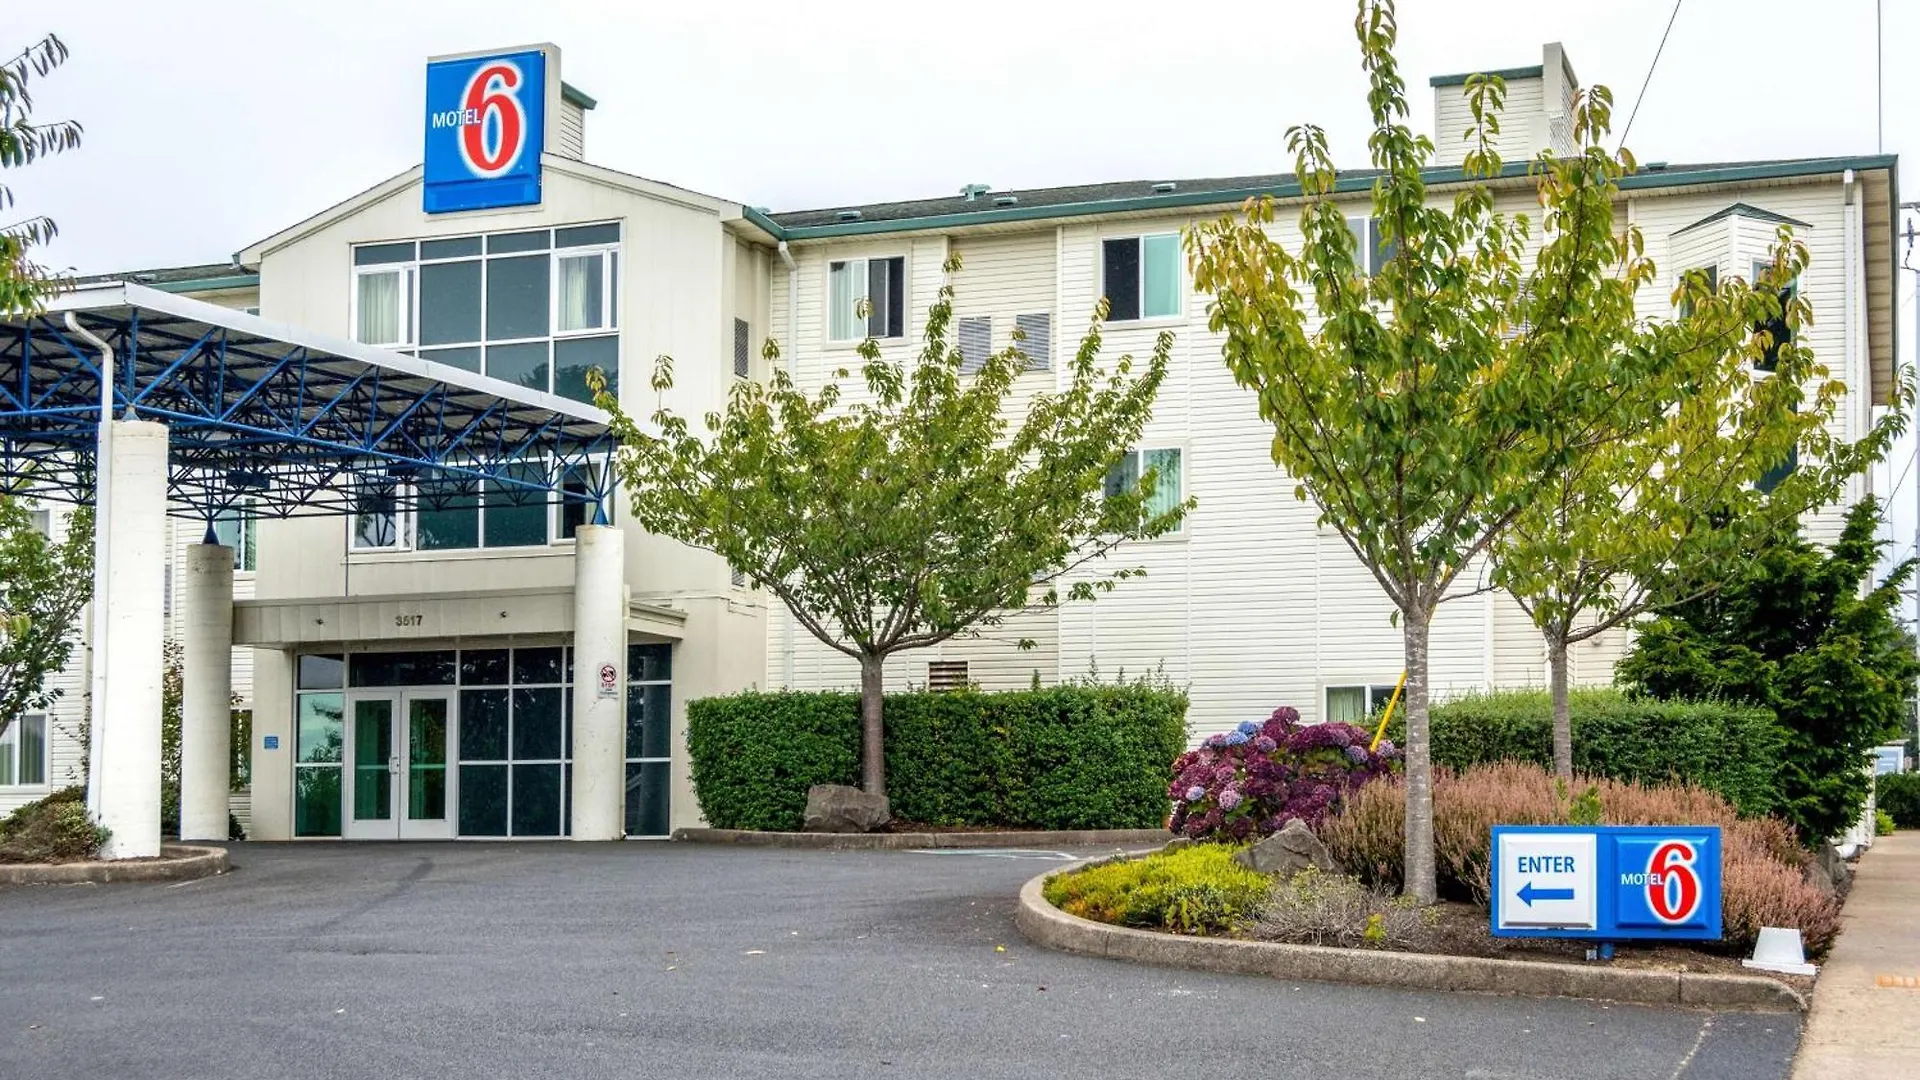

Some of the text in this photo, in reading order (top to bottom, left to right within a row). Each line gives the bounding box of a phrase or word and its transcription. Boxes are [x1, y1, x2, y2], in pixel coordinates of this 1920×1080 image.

[432, 61, 525, 177] MOTEL 6
[1518, 856, 1575, 873] ENTER
[1621, 840, 1702, 924] MOTEL 6
